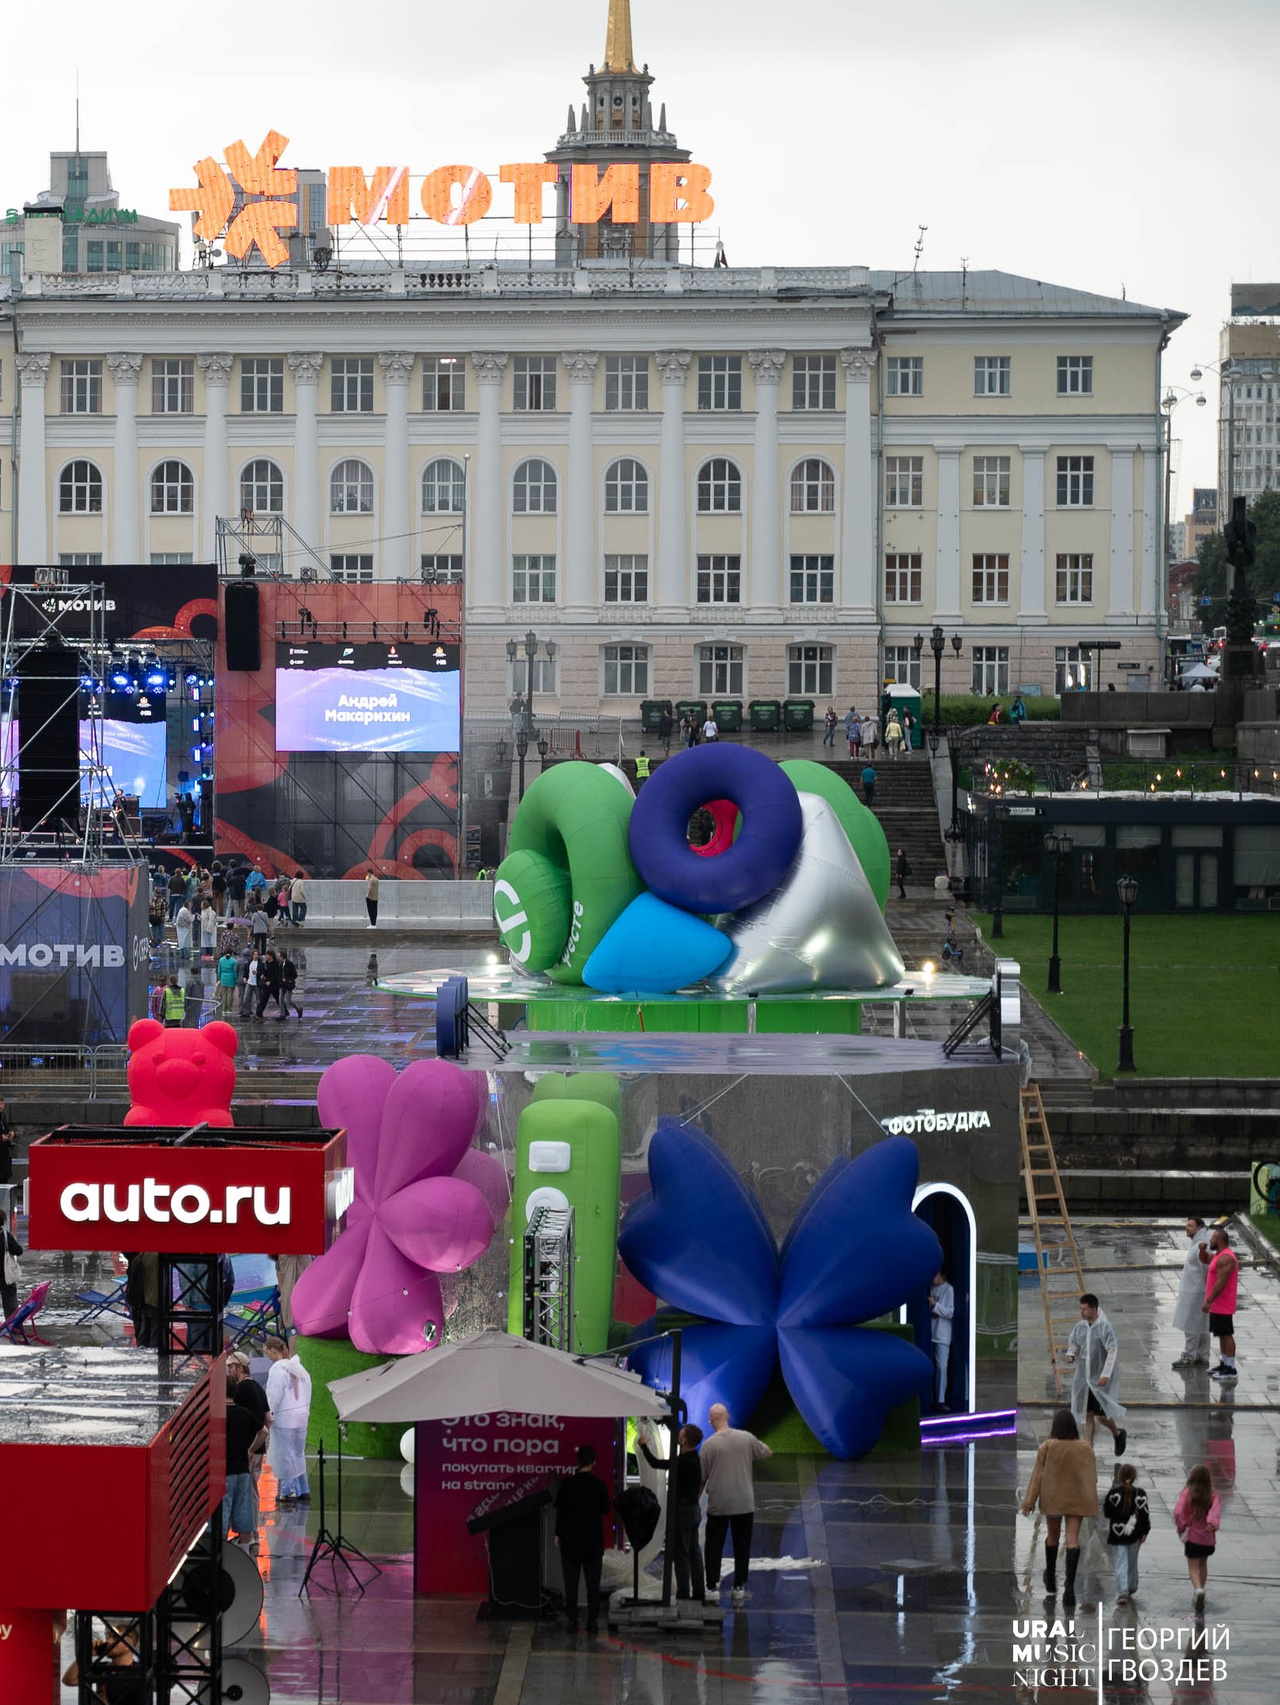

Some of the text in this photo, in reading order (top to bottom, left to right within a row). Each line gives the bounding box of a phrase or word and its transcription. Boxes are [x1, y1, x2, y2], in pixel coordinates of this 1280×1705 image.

[327, 162, 715, 226] МОТИВ
[58, 599, 117, 612] МОТИВ
[338, 694, 398, 710] Андрей
[325, 709, 411, 725] Макарихин
[59, 1177, 291, 1226] auto.ru
[496, 1413, 565, 1431] знак,
[442, 1438, 559, 1456] что пора
[442, 1463, 580, 1476] покупать квартир
[441, 1481, 462, 1490] на
